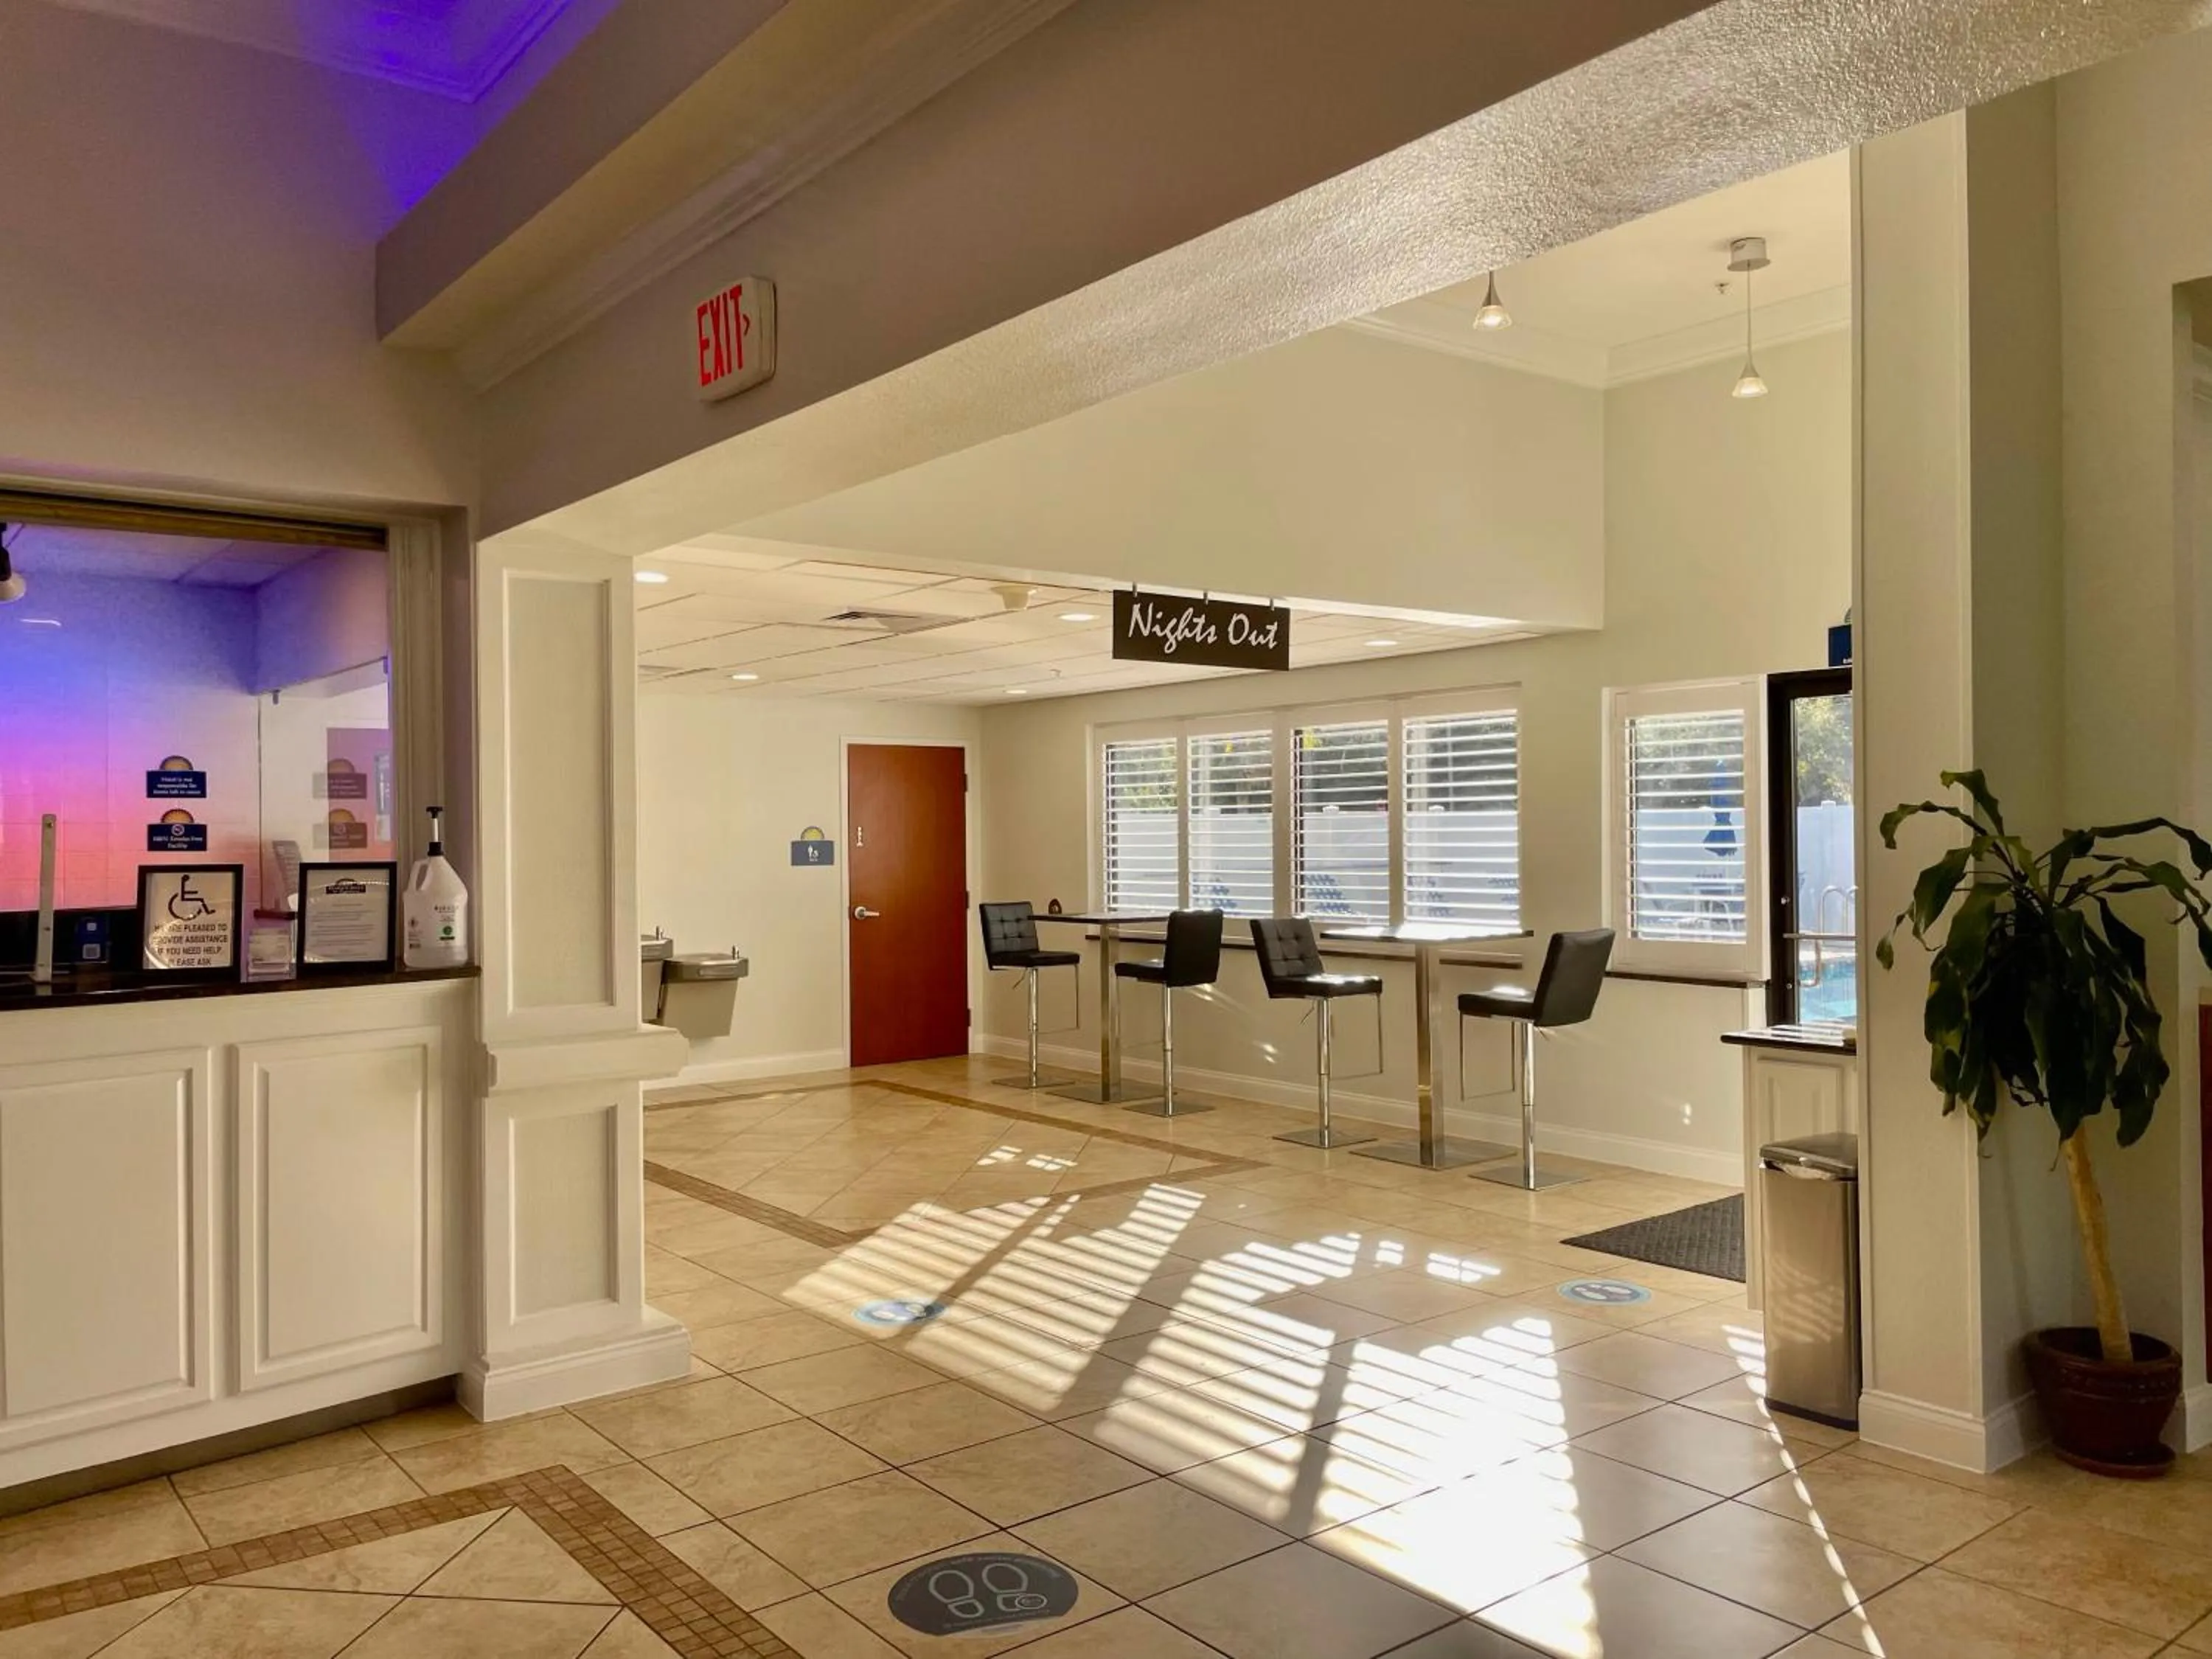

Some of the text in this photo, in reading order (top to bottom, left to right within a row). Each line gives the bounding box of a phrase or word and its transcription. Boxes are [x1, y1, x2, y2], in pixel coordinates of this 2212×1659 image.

[697, 283, 742, 386] EXIT
[1128, 602, 1278, 654] Nights Out
[184, 923, 216, 932] PLEASED
[185, 933, 228, 943] ASSISTANCE
[166, 947, 181, 955] YOU
[182, 946, 201, 954] NEED
